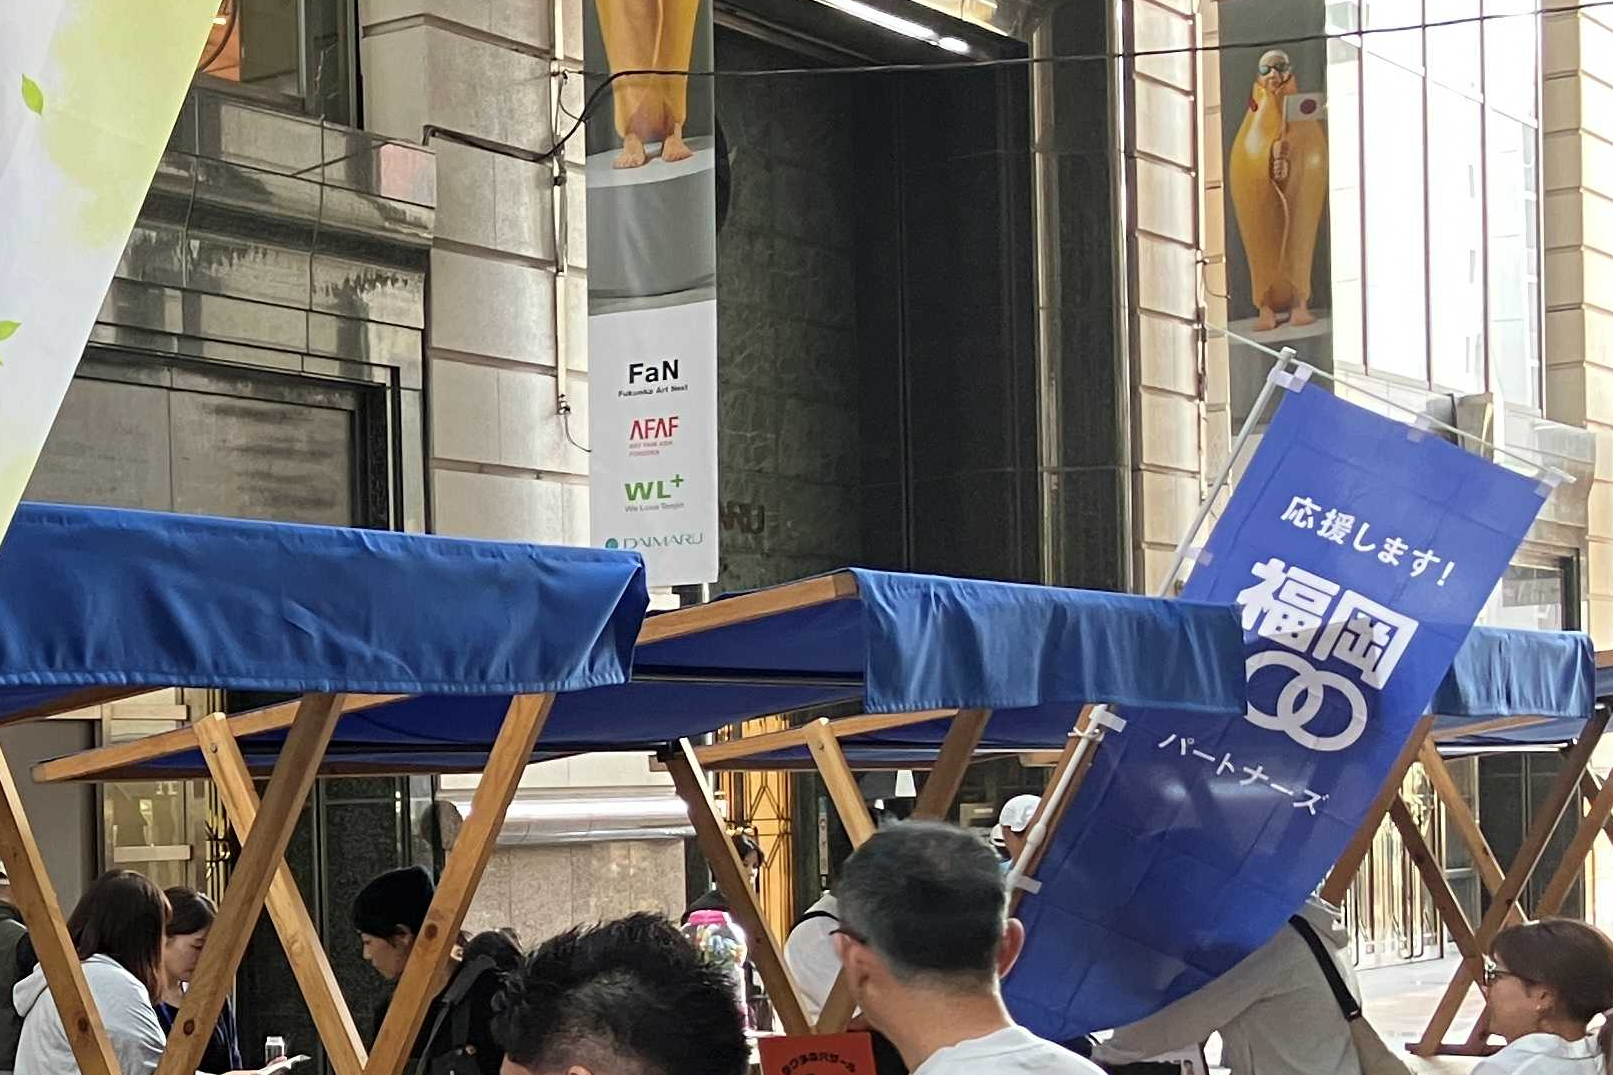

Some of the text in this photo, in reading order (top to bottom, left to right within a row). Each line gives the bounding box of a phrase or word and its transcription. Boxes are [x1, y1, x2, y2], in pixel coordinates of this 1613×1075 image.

[629, 359, 679, 384] FaN
[629, 416, 679, 440] AFAF
[1237, 558, 1419, 690] 福岡
[1157, 733, 1329, 816] パートナーズ
